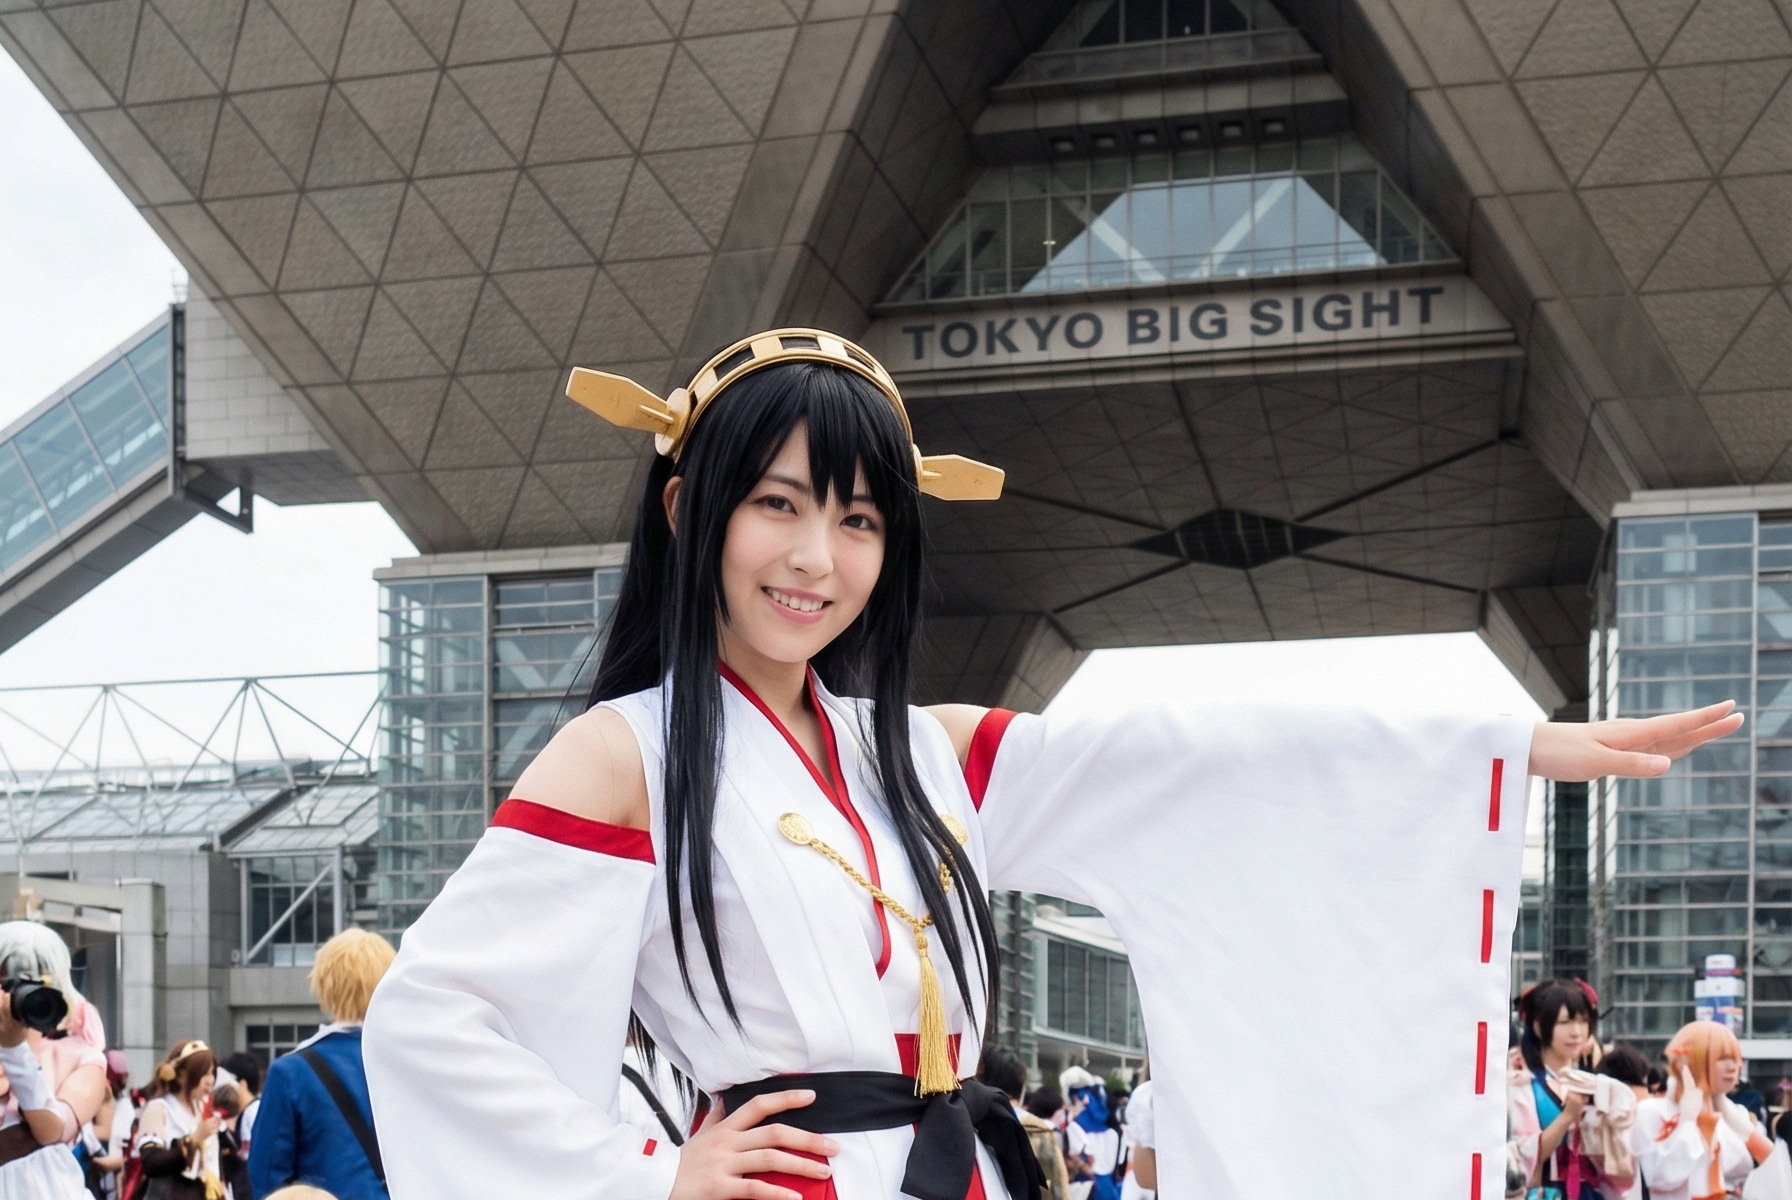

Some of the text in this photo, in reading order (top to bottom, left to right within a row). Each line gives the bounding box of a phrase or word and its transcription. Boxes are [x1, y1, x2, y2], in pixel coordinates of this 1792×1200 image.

[903, 287, 1444, 360] TOKYO BIG SIGHT
